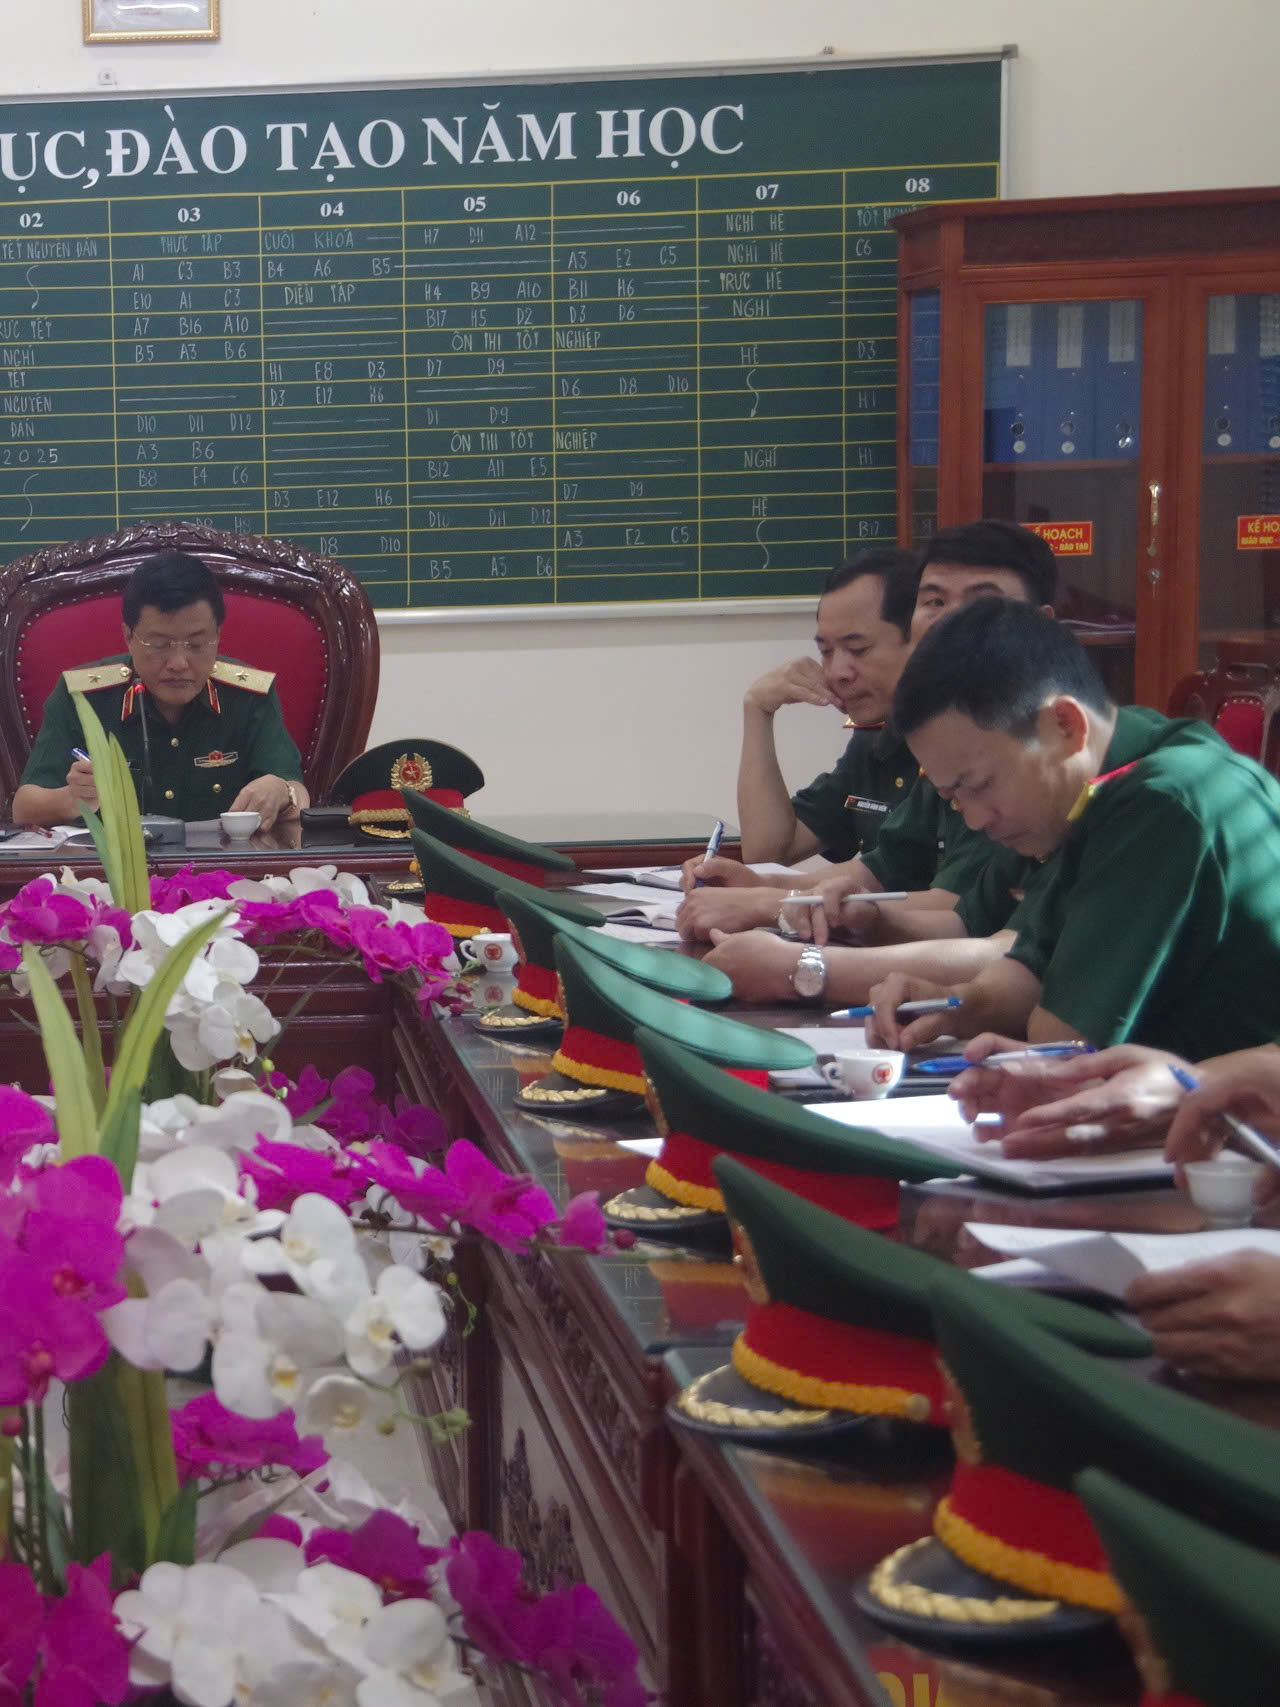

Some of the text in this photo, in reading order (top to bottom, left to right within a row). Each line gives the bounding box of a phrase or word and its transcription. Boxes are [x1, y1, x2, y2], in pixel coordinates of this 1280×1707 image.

[267, 119, 405, 182] TẠO
[423, 102, 575, 166] NĂM
[597, 104, 744, 168] HỌC
[20, 213, 43, 227] 02
[178, 207, 200, 223] 03
[320, 203, 344, 217] 04
[464, 196, 486, 212] 05
[617, 191, 641, 205] 06
[756, 185, 779, 200] 07
[905, 178, 930, 193] 08
[568, 251, 587, 269] A3
[660, 246, 677, 265] C5
[133, 261, 240, 281] A1 C3 B3
[268, 258, 391, 278] B4 A6 B5
[425, 282, 541, 301] H4 B9 A10
[618, 279, 634, 297] H6
[180, 291, 192, 308] A1
[224, 289, 240, 306] C3
[471, 309, 487, 327] H5
[517, 308, 533, 325] D2
[570, 303, 635, 323] D3 D6
[134, 316, 249, 335] A7 B16 A10
[135, 342, 246, 362] B5 A3 B6
[270, 363, 282, 380] H1
[368, 361, 385, 378] D3
[428, 357, 505, 376] D7 D9
[271, 389, 285, 406] D3
[370, 386, 383, 403] H6
[1043, 528, 1083, 541] HOẠCH
